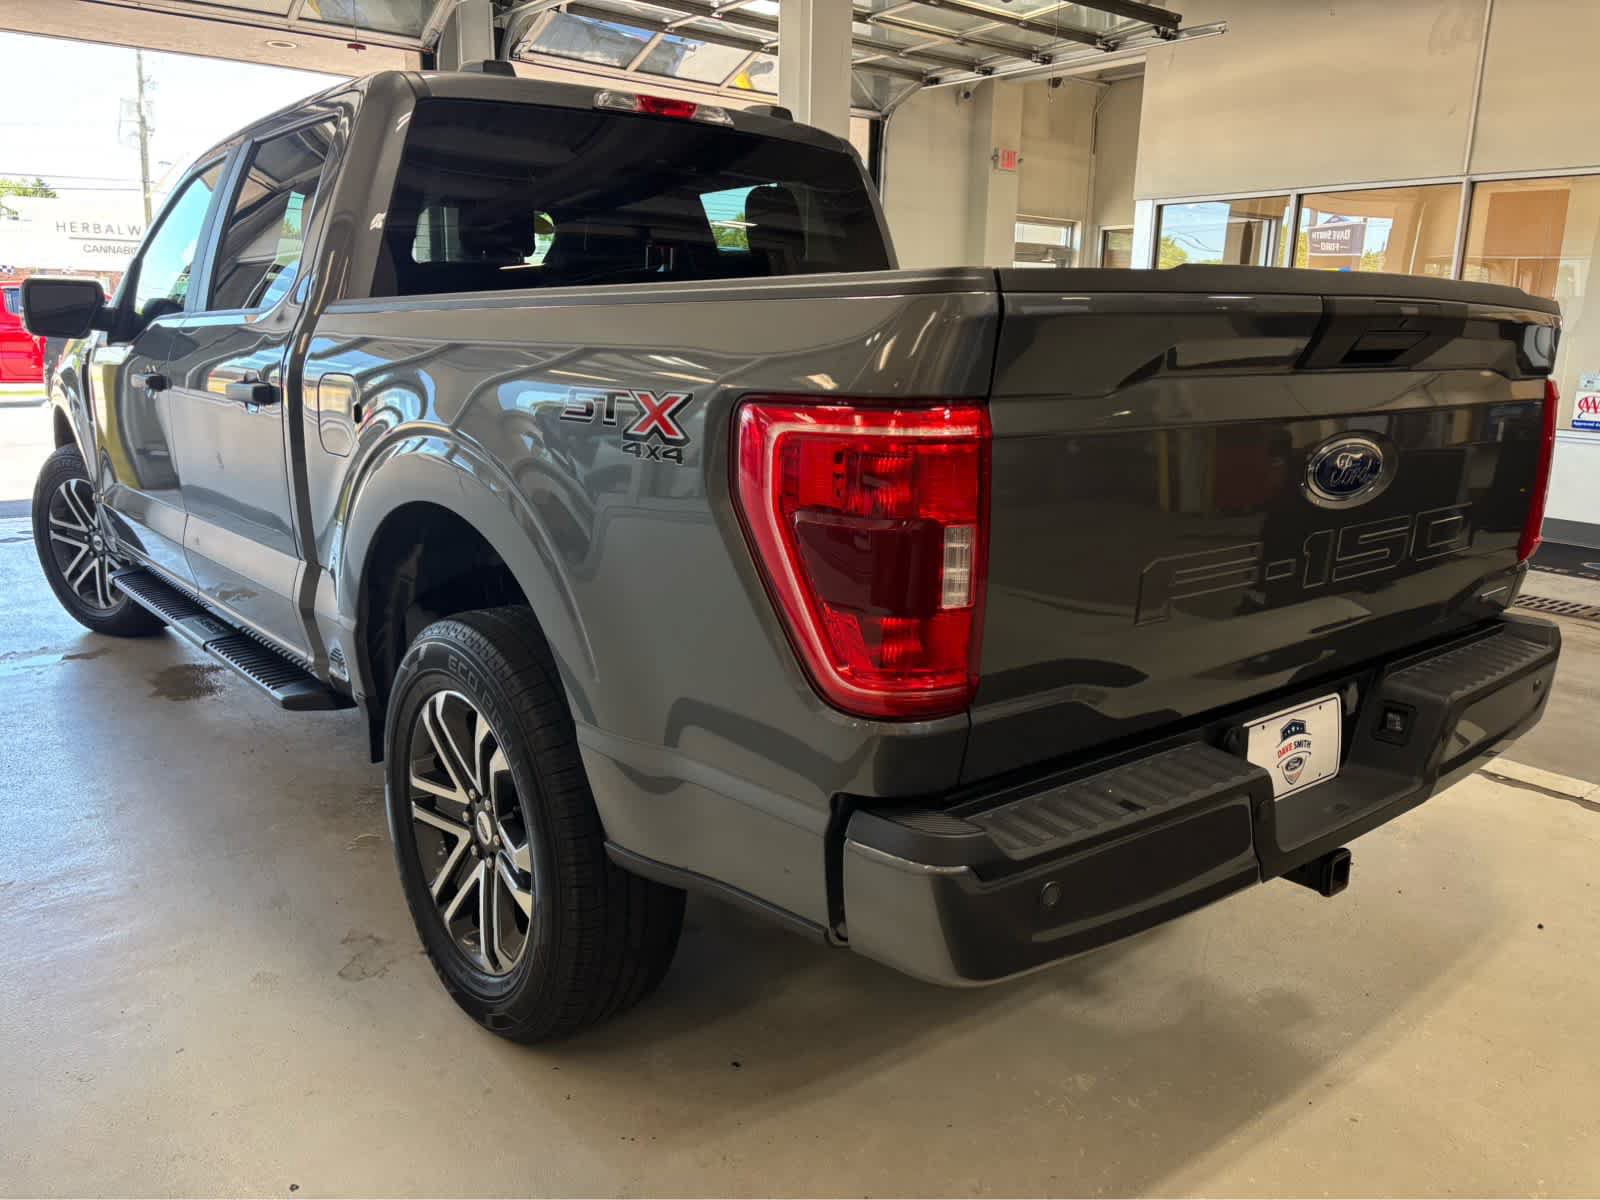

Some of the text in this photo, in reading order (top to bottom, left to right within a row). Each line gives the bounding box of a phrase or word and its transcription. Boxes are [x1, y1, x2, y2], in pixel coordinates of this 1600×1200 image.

[560, 386, 694, 447] STX
[1330, 452, 1373, 488] Ford
[1135, 502, 1473, 626] F-150
[1277, 739, 1312, 758] DAVE SMITH
